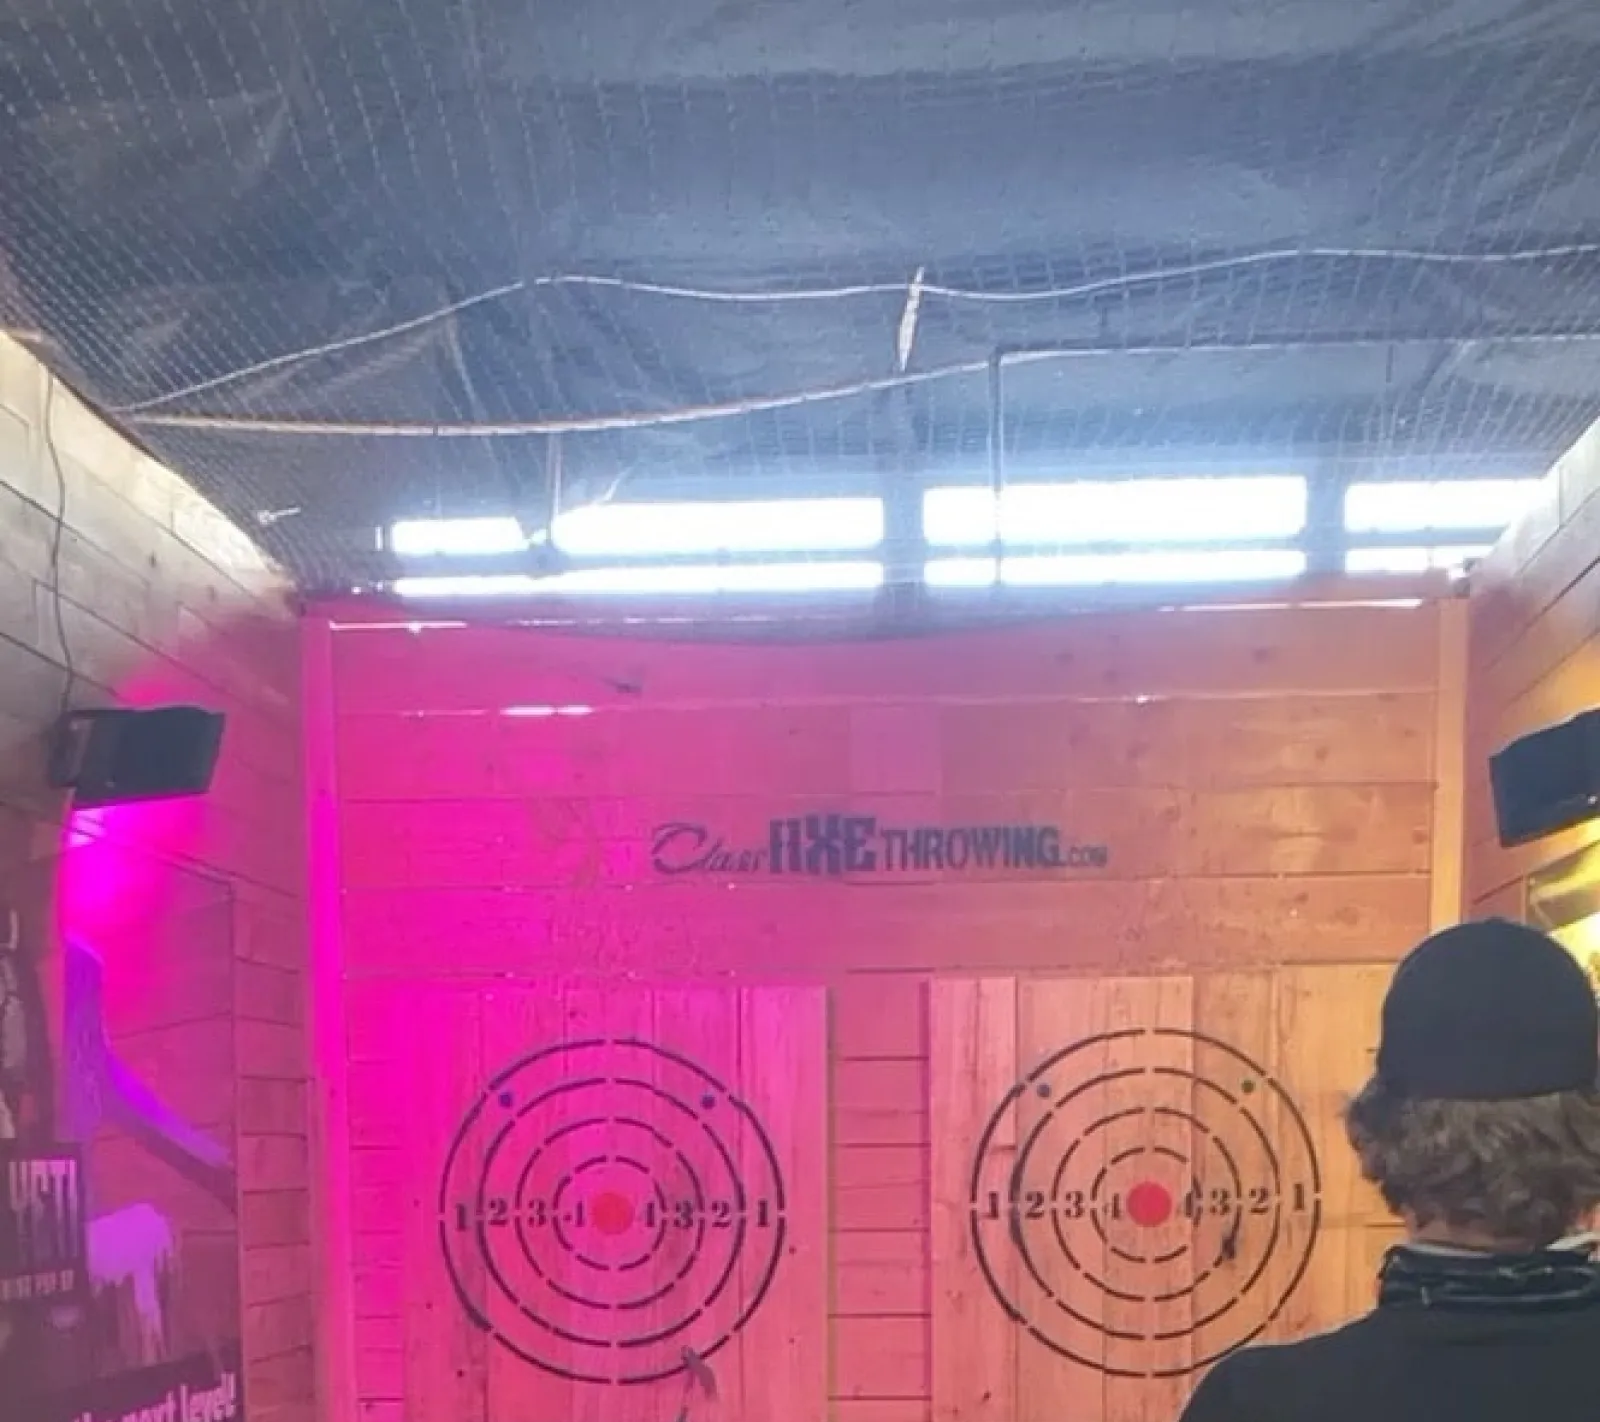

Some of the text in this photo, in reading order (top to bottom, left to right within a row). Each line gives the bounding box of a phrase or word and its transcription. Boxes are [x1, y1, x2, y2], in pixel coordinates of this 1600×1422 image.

[489, 1198, 508, 1226] 2
[528, 1199, 547, 1227] 3
[673, 1200, 694, 1229] 3
[711, 1201, 731, 1228] 2
[756, 1199, 769, 1228] 1
[1025, 1191, 1044, 1219] 2
[1066, 1191, 1084, 1218] 3
[1210, 1187, 1231, 1215] 3
[1250, 1187, 1269, 1215] 2
[1294, 1183, 1305, 1210] 1
